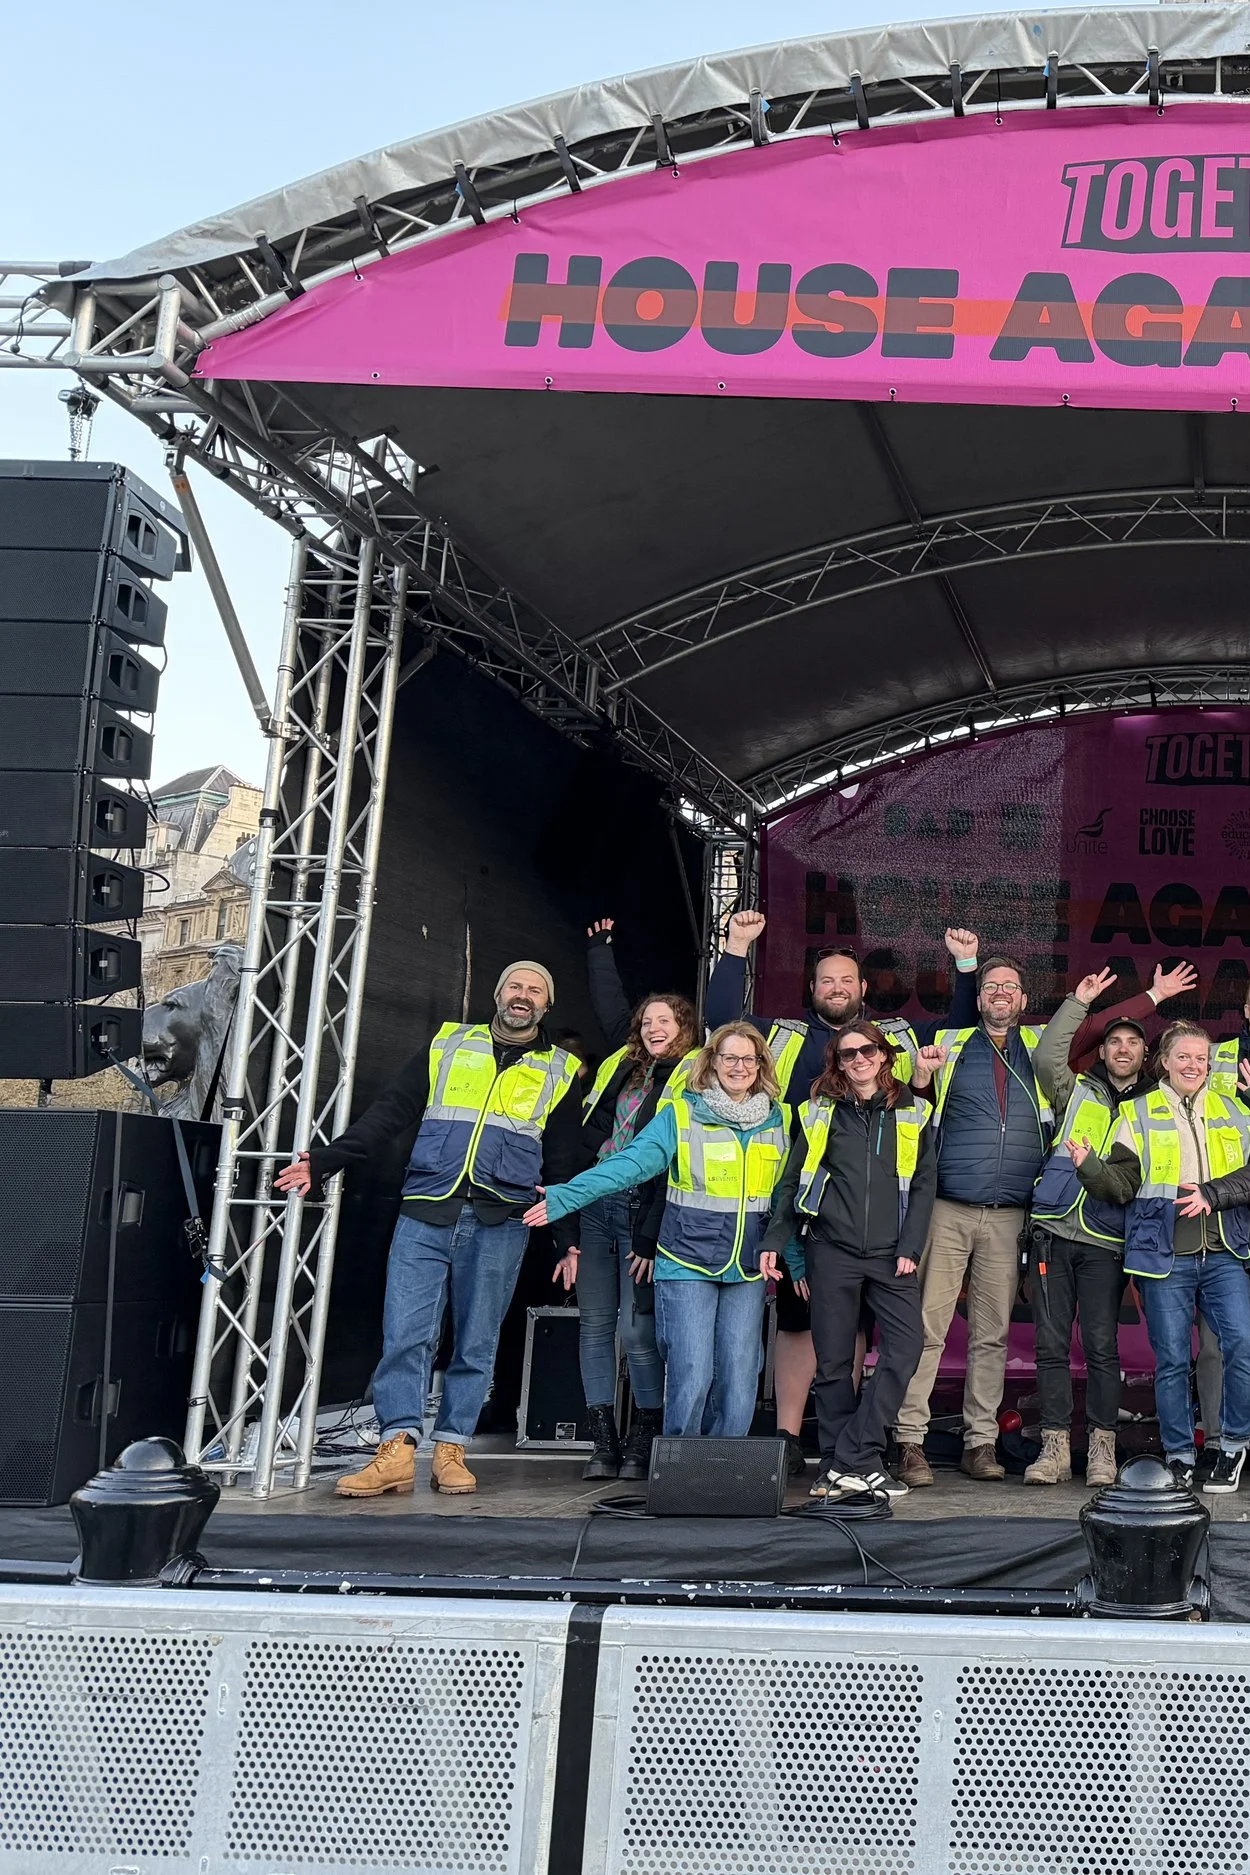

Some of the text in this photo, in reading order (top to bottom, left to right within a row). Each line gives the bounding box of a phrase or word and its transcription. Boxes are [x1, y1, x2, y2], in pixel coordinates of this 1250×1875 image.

[503, 252, 960, 359] HOUSE
[1139, 808, 1195, 826] CHOOSE
[1138, 828, 1195, 857] LOVE
